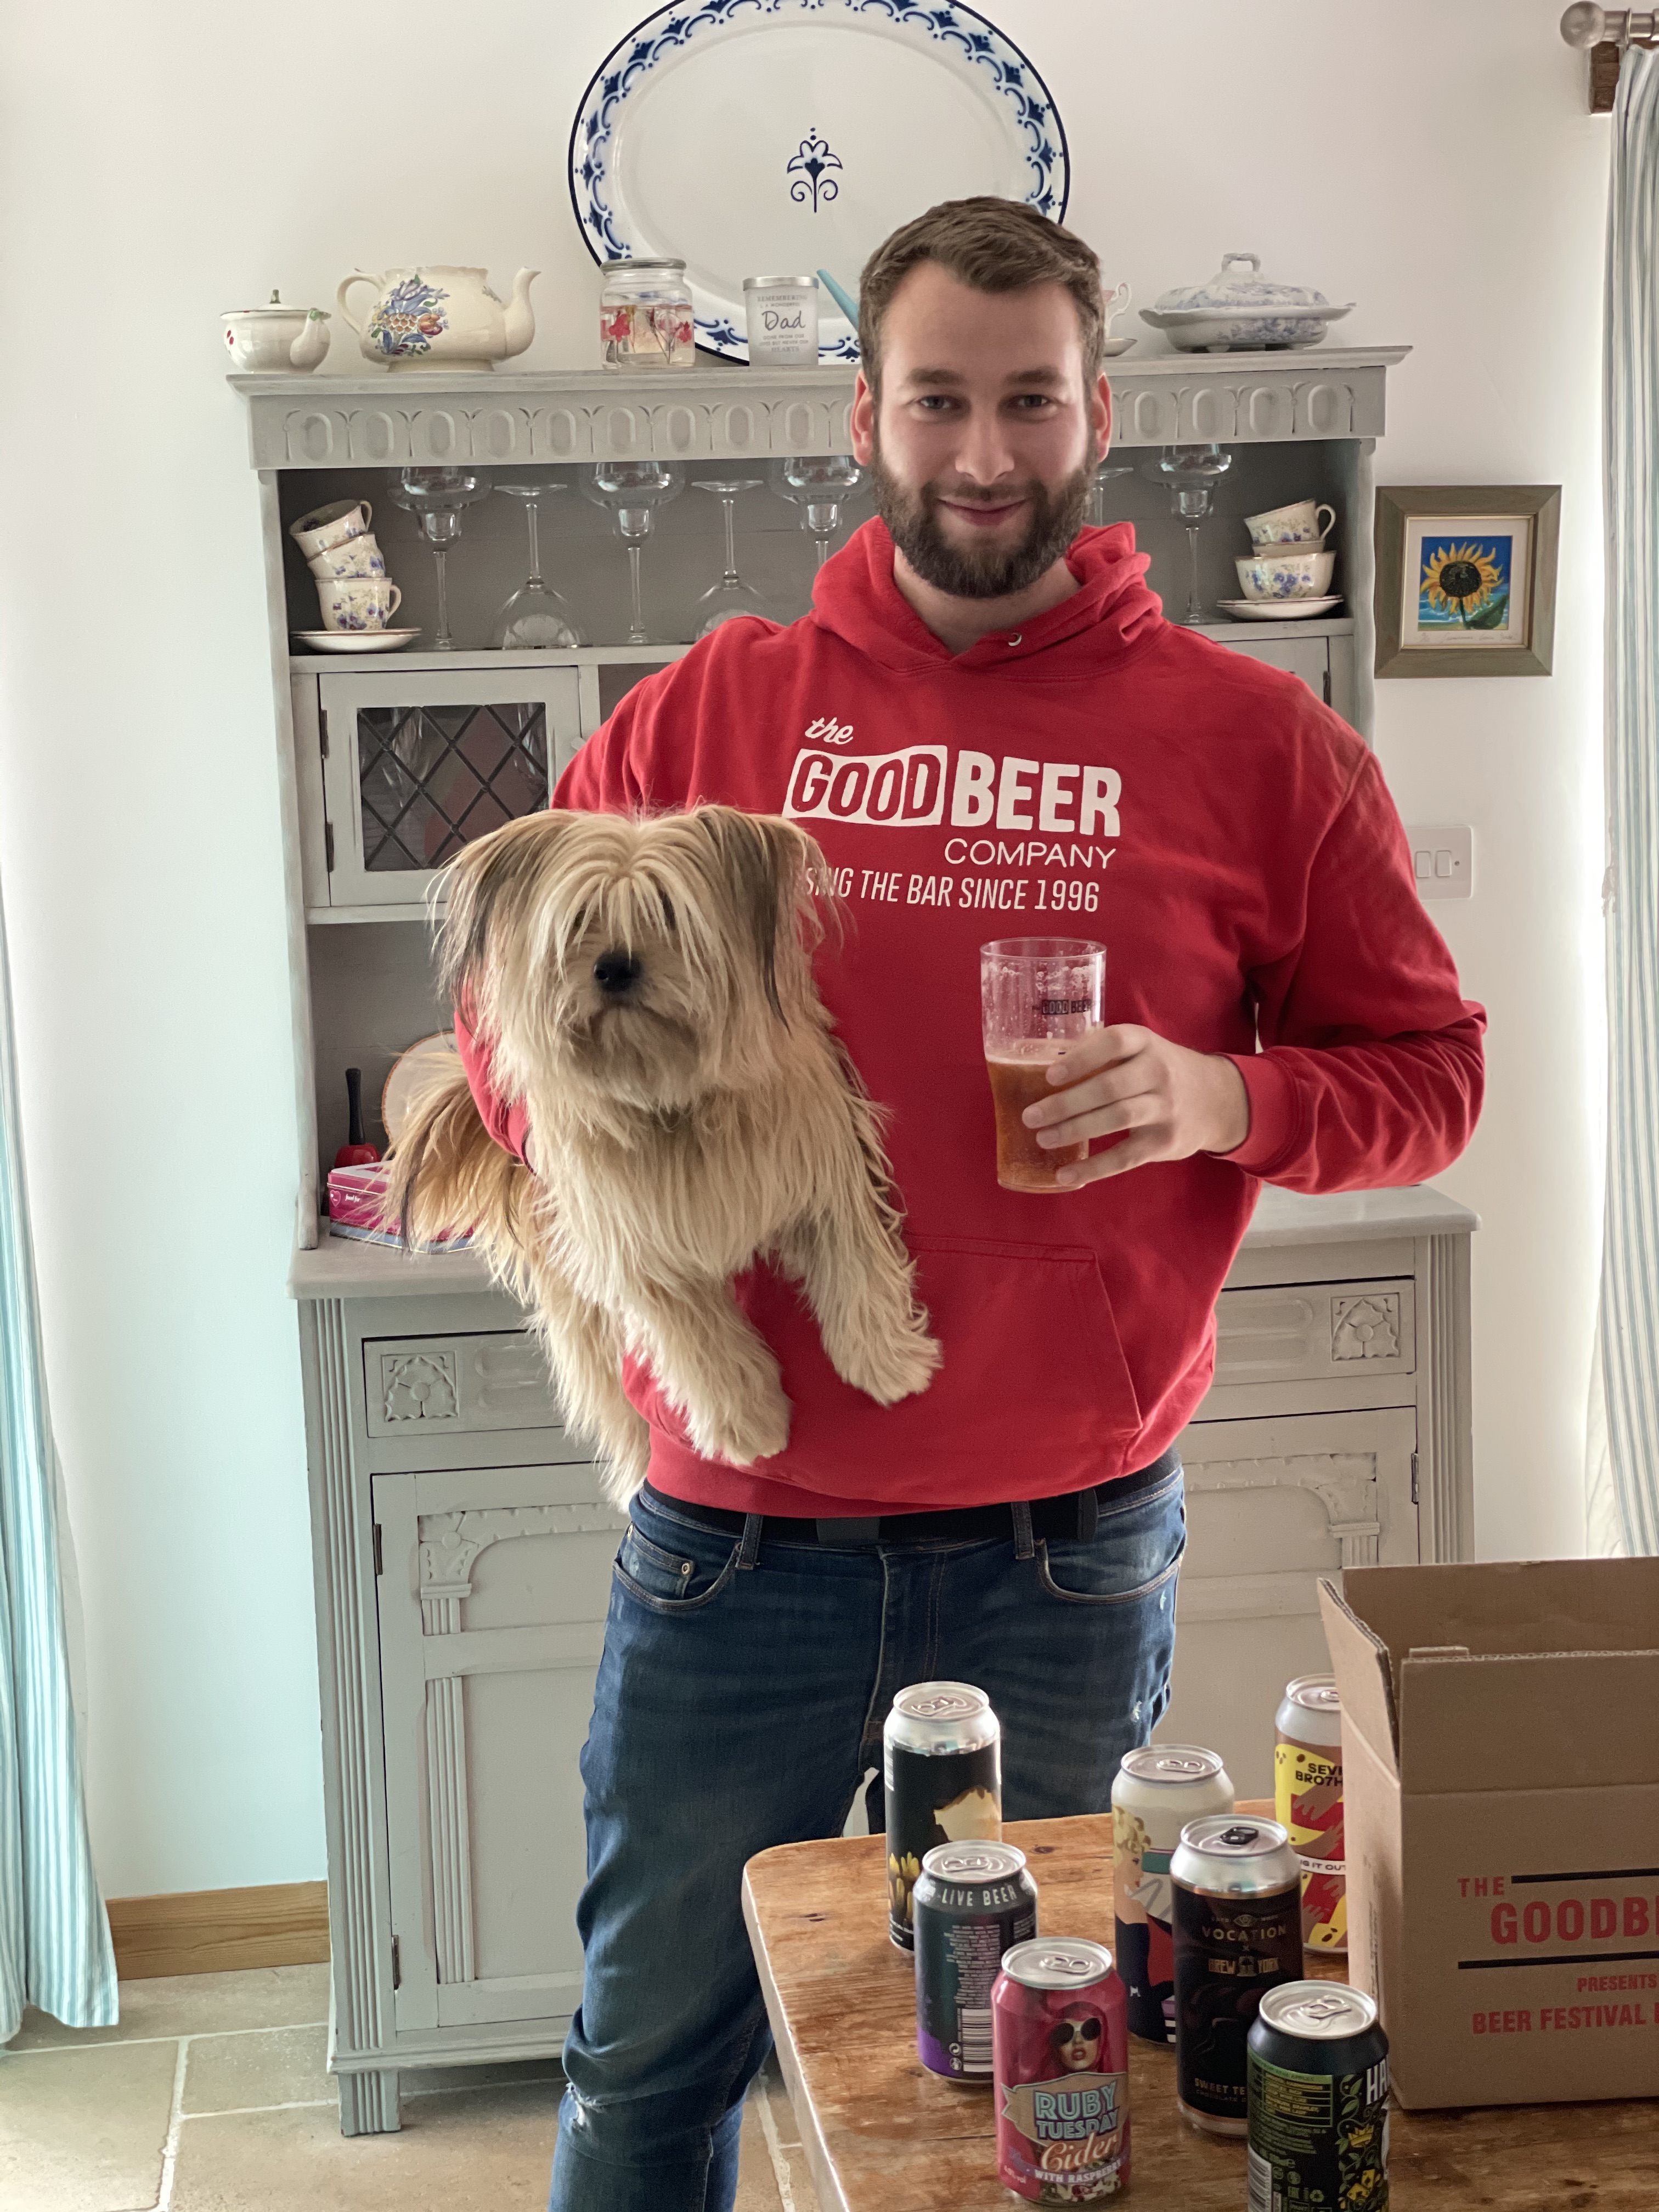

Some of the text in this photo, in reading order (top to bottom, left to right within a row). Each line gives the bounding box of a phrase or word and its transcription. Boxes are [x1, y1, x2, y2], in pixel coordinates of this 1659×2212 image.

[761, 310, 806, 331] Dad
[804, 716, 854, 746] the
[788, 749, 1123, 837] GOOD BEER
[944, 838, 1117, 870] COMPANY
[861, 870, 903, 902] THE
[906, 874, 953, 907] BAR
[958, 878, 1029, 910] SINCE
[1034, 880, 1099, 912] 1996
[941, 1884, 1017, 1906] LIVE BEER
[1457, 1876, 1505, 1898] THE
[1201, 1924, 1286, 1942] VOCATION
[1491, 1895, 1659, 1945] GOODB
[1577, 1973, 1657, 1992] PRESENTS
[1472, 2010, 1532, 2035] BEER
[1540, 2004, 1647, 2031] FESTIVAL
[1035, 2080, 1117, 2121] RUBY
[1036, 2108, 1119, 2140] TUESDAY
[1041, 2132, 1118, 2171] Cider
[1035, 2159, 1121, 2183] WITH RASPBERRY
